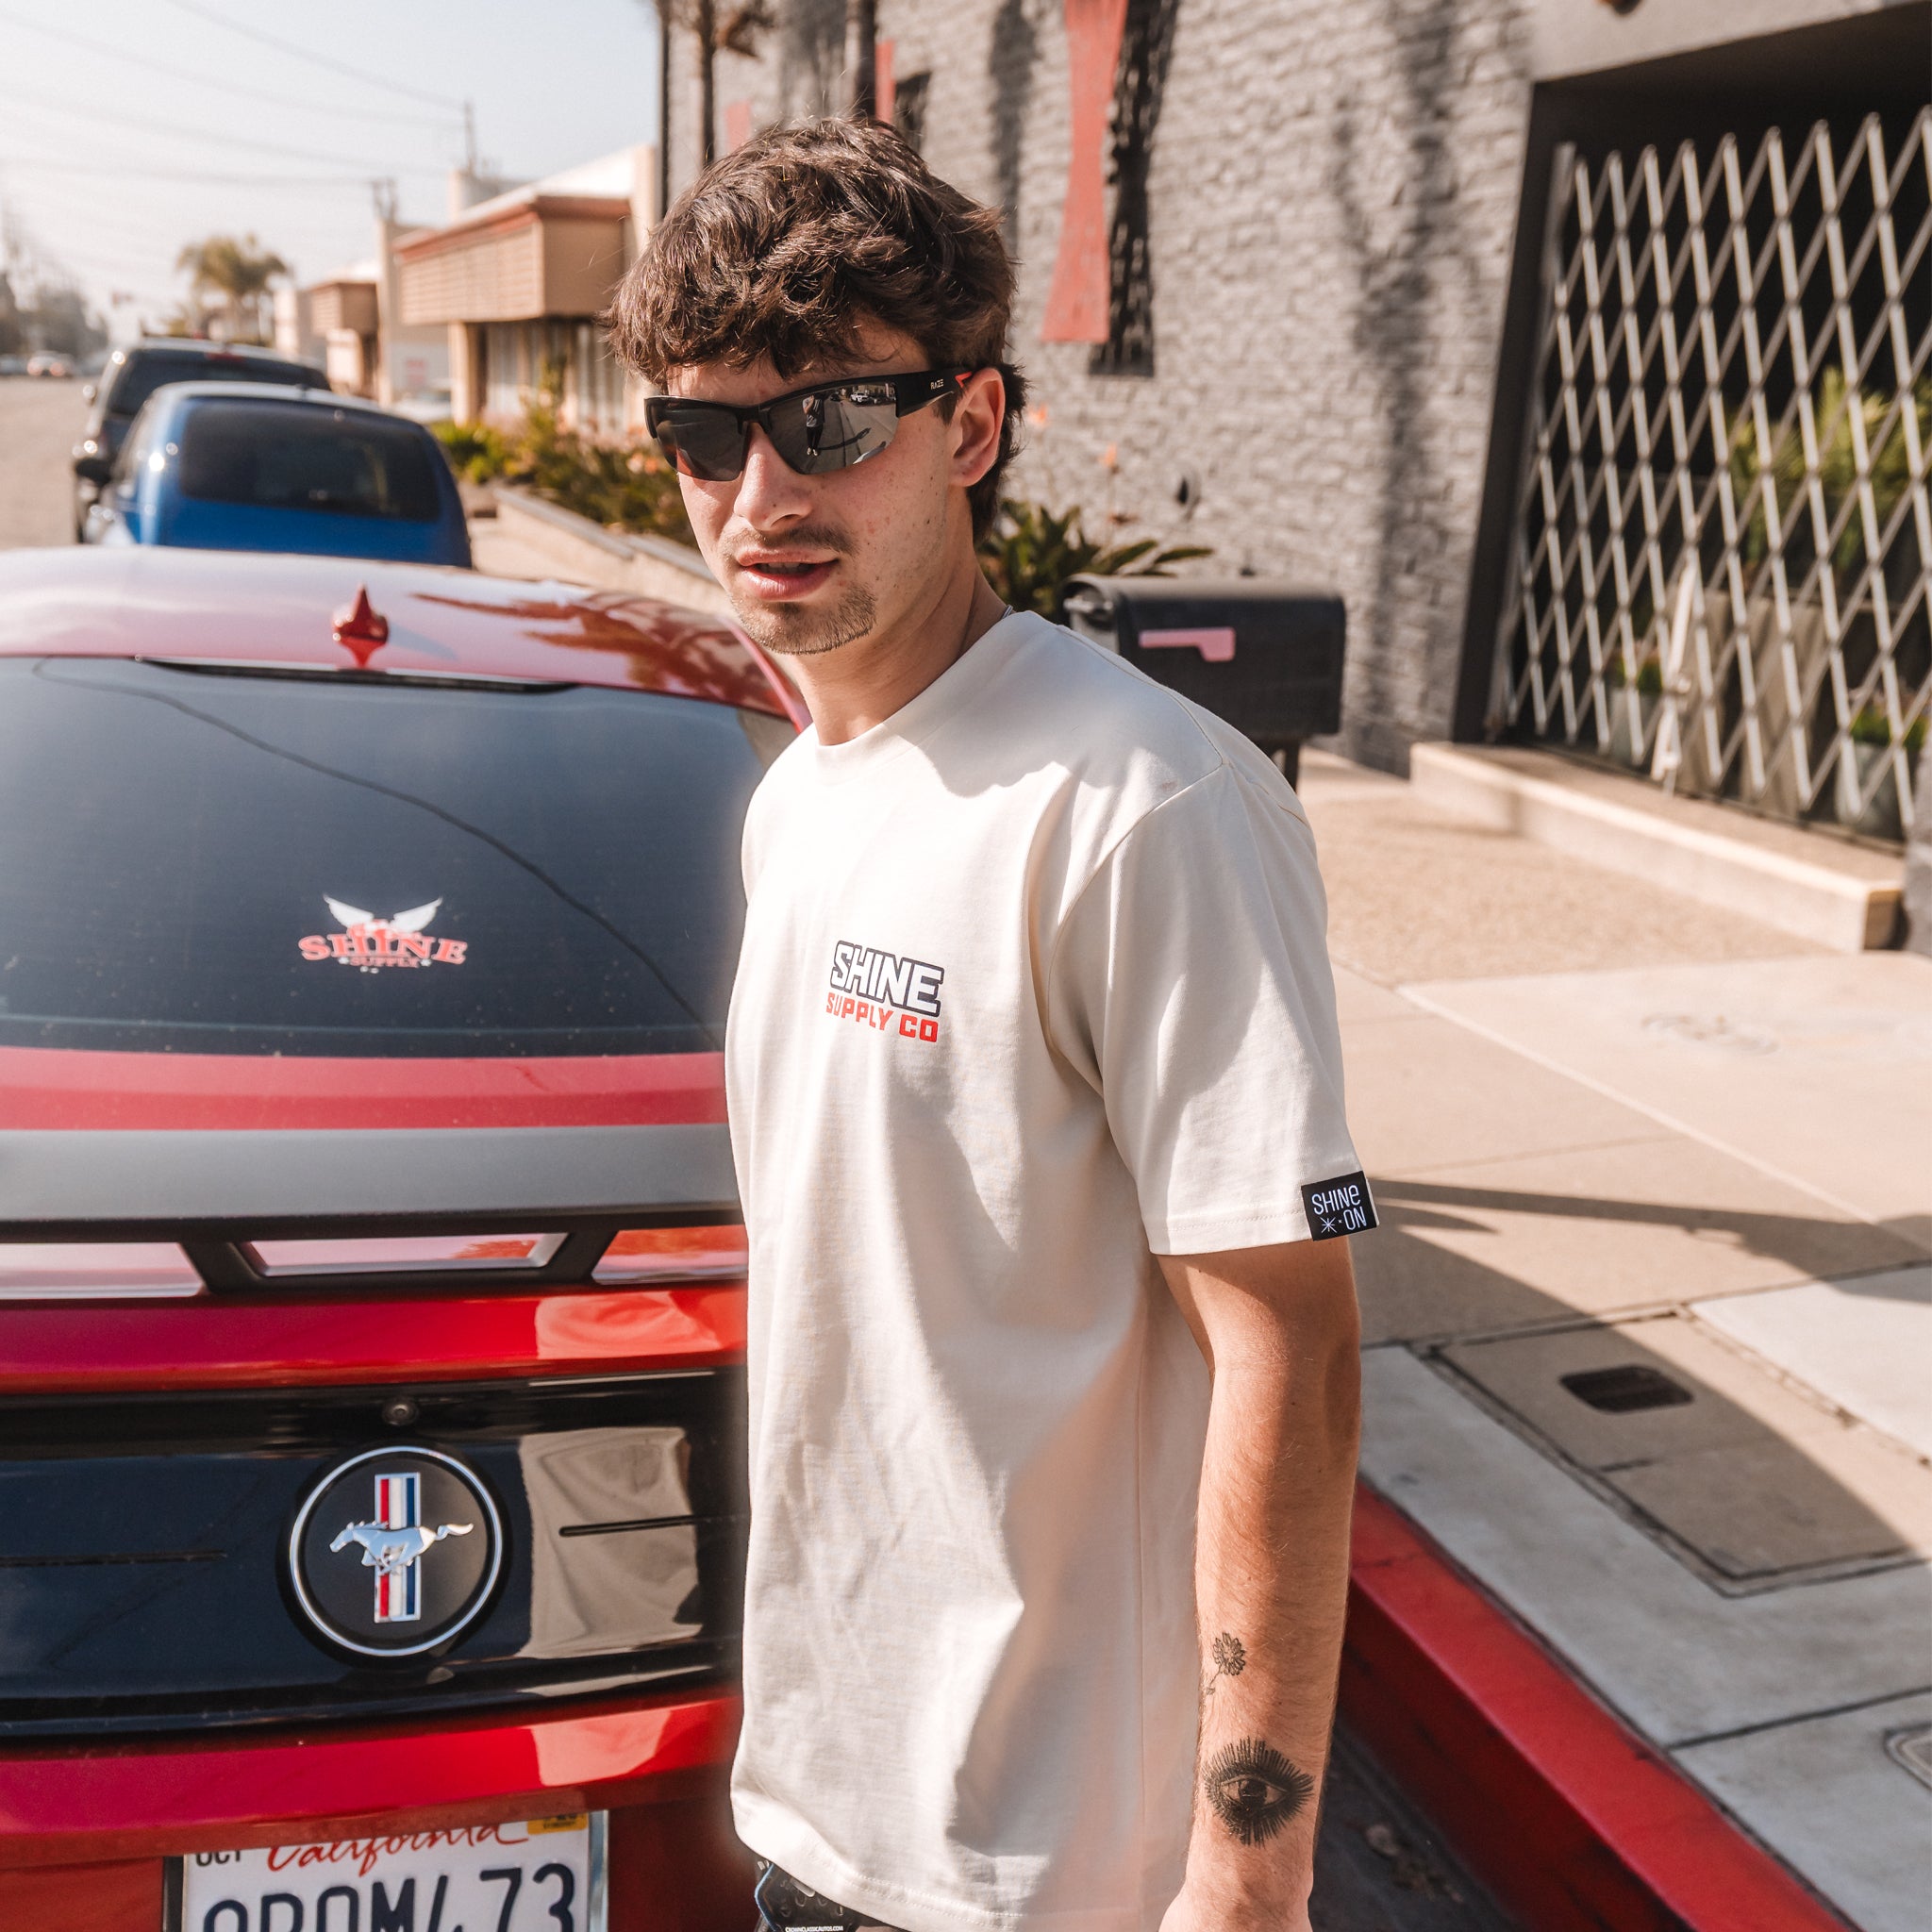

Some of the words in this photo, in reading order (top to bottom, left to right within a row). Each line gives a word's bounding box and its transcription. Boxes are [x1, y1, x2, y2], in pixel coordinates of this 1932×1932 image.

[298, 925, 468, 965] SHINE
[830, 940, 944, 1017] SHINE
[826, 991, 894, 1031] SUPPLY
[899, 1013, 939, 1042] CO
[1342, 1206, 1367, 1230] ON
